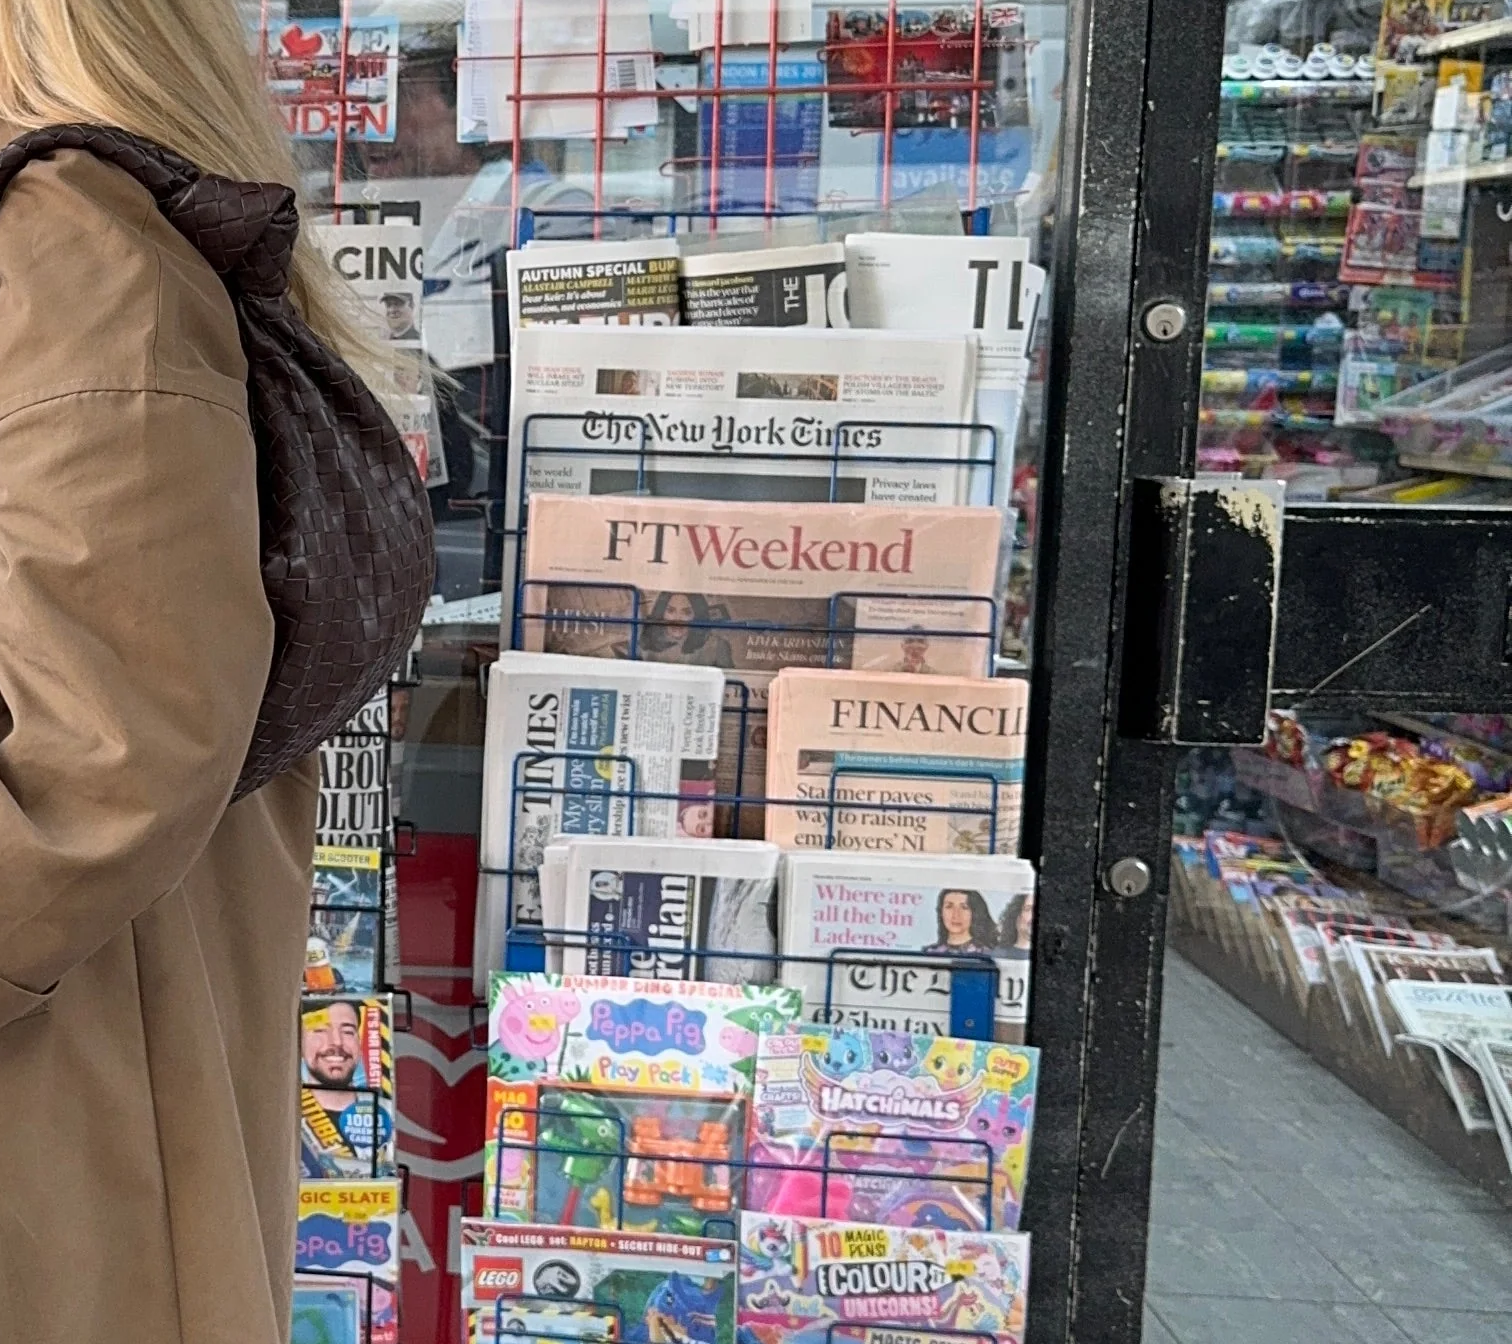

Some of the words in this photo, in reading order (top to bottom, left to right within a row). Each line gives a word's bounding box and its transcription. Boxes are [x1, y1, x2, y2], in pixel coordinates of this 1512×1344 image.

[521, 264, 585, 283] AUTUMN
[586, 261, 646, 278] SPECIAL
[567, 277, 614, 290] CAMPBELL
[580, 289, 606, 299] about
[782, 276, 801, 315] THE
[522, 303, 554, 316] emotion,
[555, 302, 575, 313] not
[576, 298, 623, 311] economics
[581, 410, 637, 446] The
[645, 413, 704, 444] New
[711, 415, 783, 454] York
[790, 416, 883, 448] Times
[546, 466, 573, 477] world
[556, 479, 582, 490] want
[871, 477, 910, 492] Privacy
[912, 478, 937, 490] laws
[871, 491, 897, 502] have
[898, 491, 938, 503] created
[619, 694, 632, 721] twist
[682, 695, 695, 727] Cooper
[619, 723, 630, 745] new
[522, 692, 560, 813] TIMES
[796, 782, 879, 803] Stamer
[882, 787, 934, 813] paves
[838, 809, 858, 825] to
[861, 809, 927, 831] raising
[902, 834, 926, 851] NI
[327, 852, 370, 866] SCOOTER
[816, 883, 883, 906] Where
[887, 889, 924, 906] are
[812, 906, 835, 927] all
[839, 906, 876, 927] the
[880, 906, 915, 927] bin
[814, 925, 898, 947] Ladens?
[563, 975, 631, 997] BUMPER
[849, 962, 918, 998] The
[591, 1006, 664, 1049] Peppa
[665, 1008, 706, 1050] Pig
[368, 1048, 381, 1088] BEAST!
[599, 1057, 640, 1084] Play
[650, 1059, 693, 1085] Pack
[299, 1190, 334, 1205] GIC
[337, 1190, 391, 1205] SLATE
[347, 1221, 386, 1264] Pig
[494, 1232, 518, 1246] Cool
[520, 1234, 544, 1247] LEGO
[547, 1236, 568, 1248] set:
[569, 1237, 607, 1250] RAPTOR
[617, 1239, 653, 1253] SECRET
[655, 1241, 702, 1256] HIDE-OUT
[816, 1230, 842, 1259] 10
[844, 1228, 886, 1243] MAGIC
[849, 1242, 887, 1260] PENS!
[477, 1269, 521, 1288] LEGO
[842, 1295, 939, 1319] UNICORNS!
